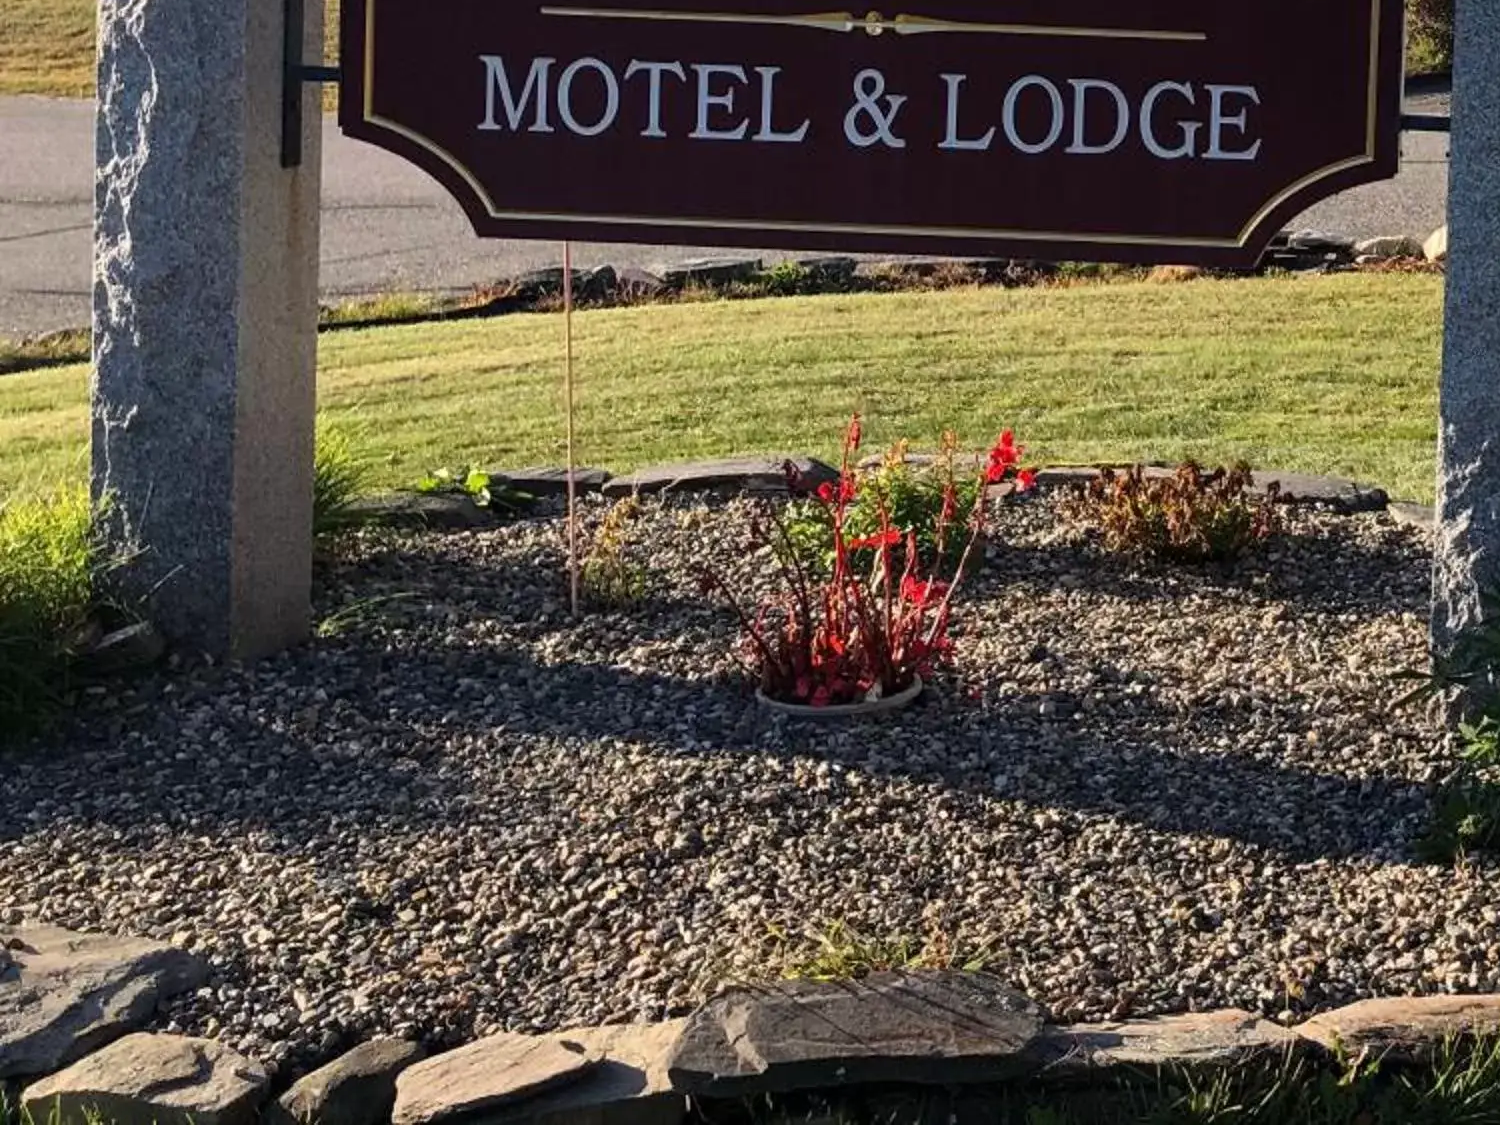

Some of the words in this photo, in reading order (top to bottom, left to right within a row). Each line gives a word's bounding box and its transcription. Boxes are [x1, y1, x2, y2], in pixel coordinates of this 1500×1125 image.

[477, 55, 811, 142] MOTEL
[843, 68, 908, 148] &
[937, 73, 1262, 160] LODGE
